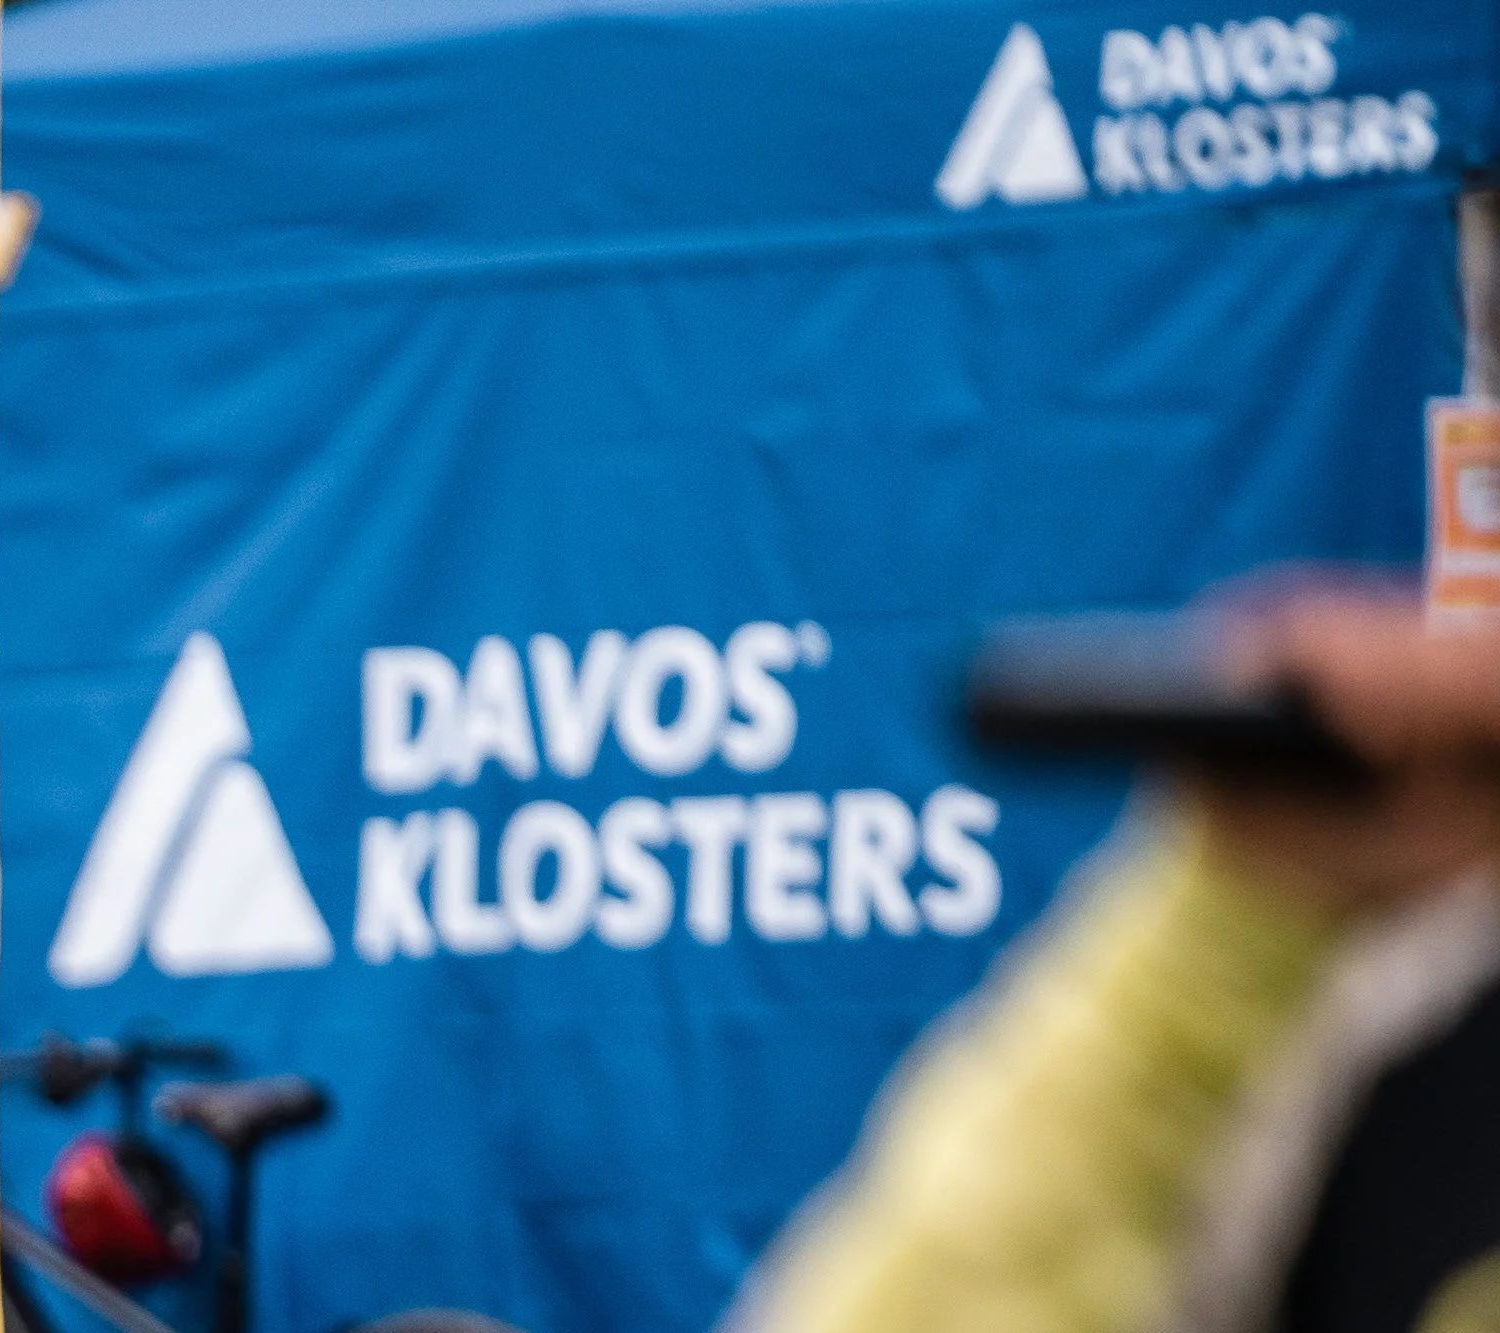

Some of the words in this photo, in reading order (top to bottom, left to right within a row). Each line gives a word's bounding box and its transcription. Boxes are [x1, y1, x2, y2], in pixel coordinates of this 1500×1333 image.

[1101, 13, 1337, 111] DAVOS
[1092, 90, 1439, 194] KLOSTERS
[361, 621, 800, 795] DAVOS
[354, 784, 1002, 966] KLOSTERS
